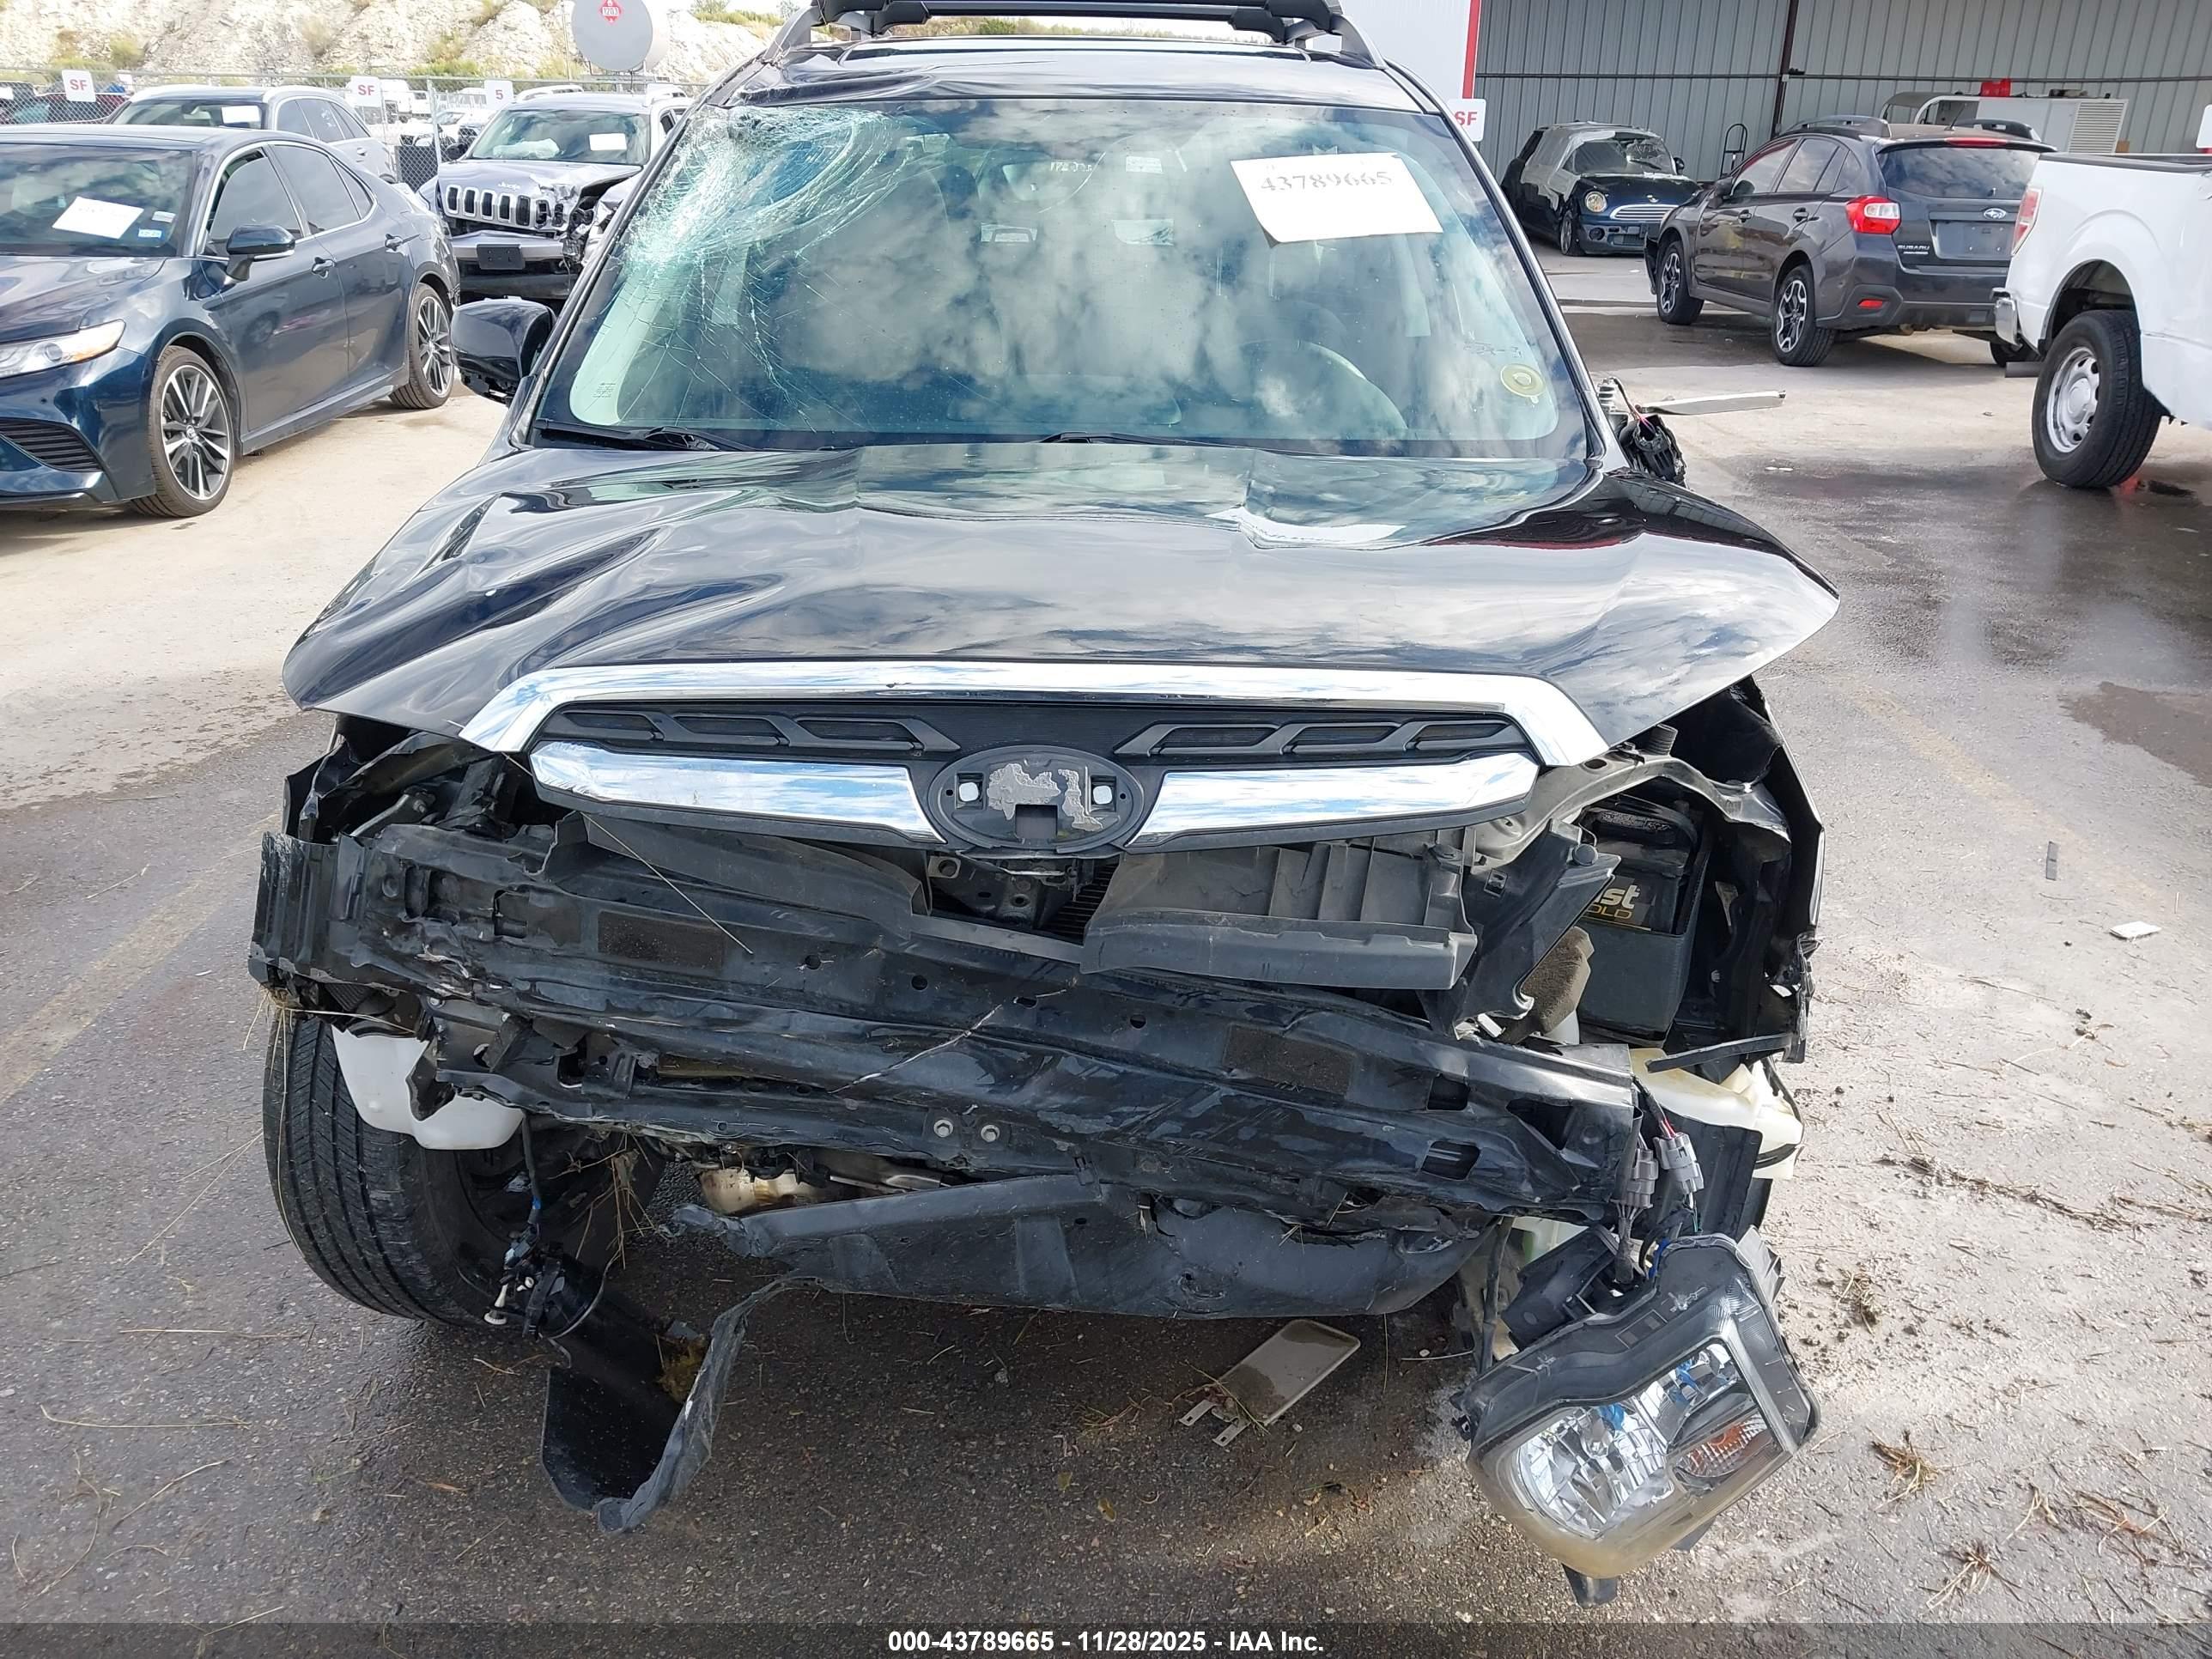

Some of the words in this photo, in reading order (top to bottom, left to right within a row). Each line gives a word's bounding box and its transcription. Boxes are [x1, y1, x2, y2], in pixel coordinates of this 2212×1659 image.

[70, 79, 88, 91] SF
[358, 84, 374, 95] SF
[495, 89, 503, 100] 5
[1455, 111, 1477, 125] SF
[1261, 171, 1393, 191] 43789665
